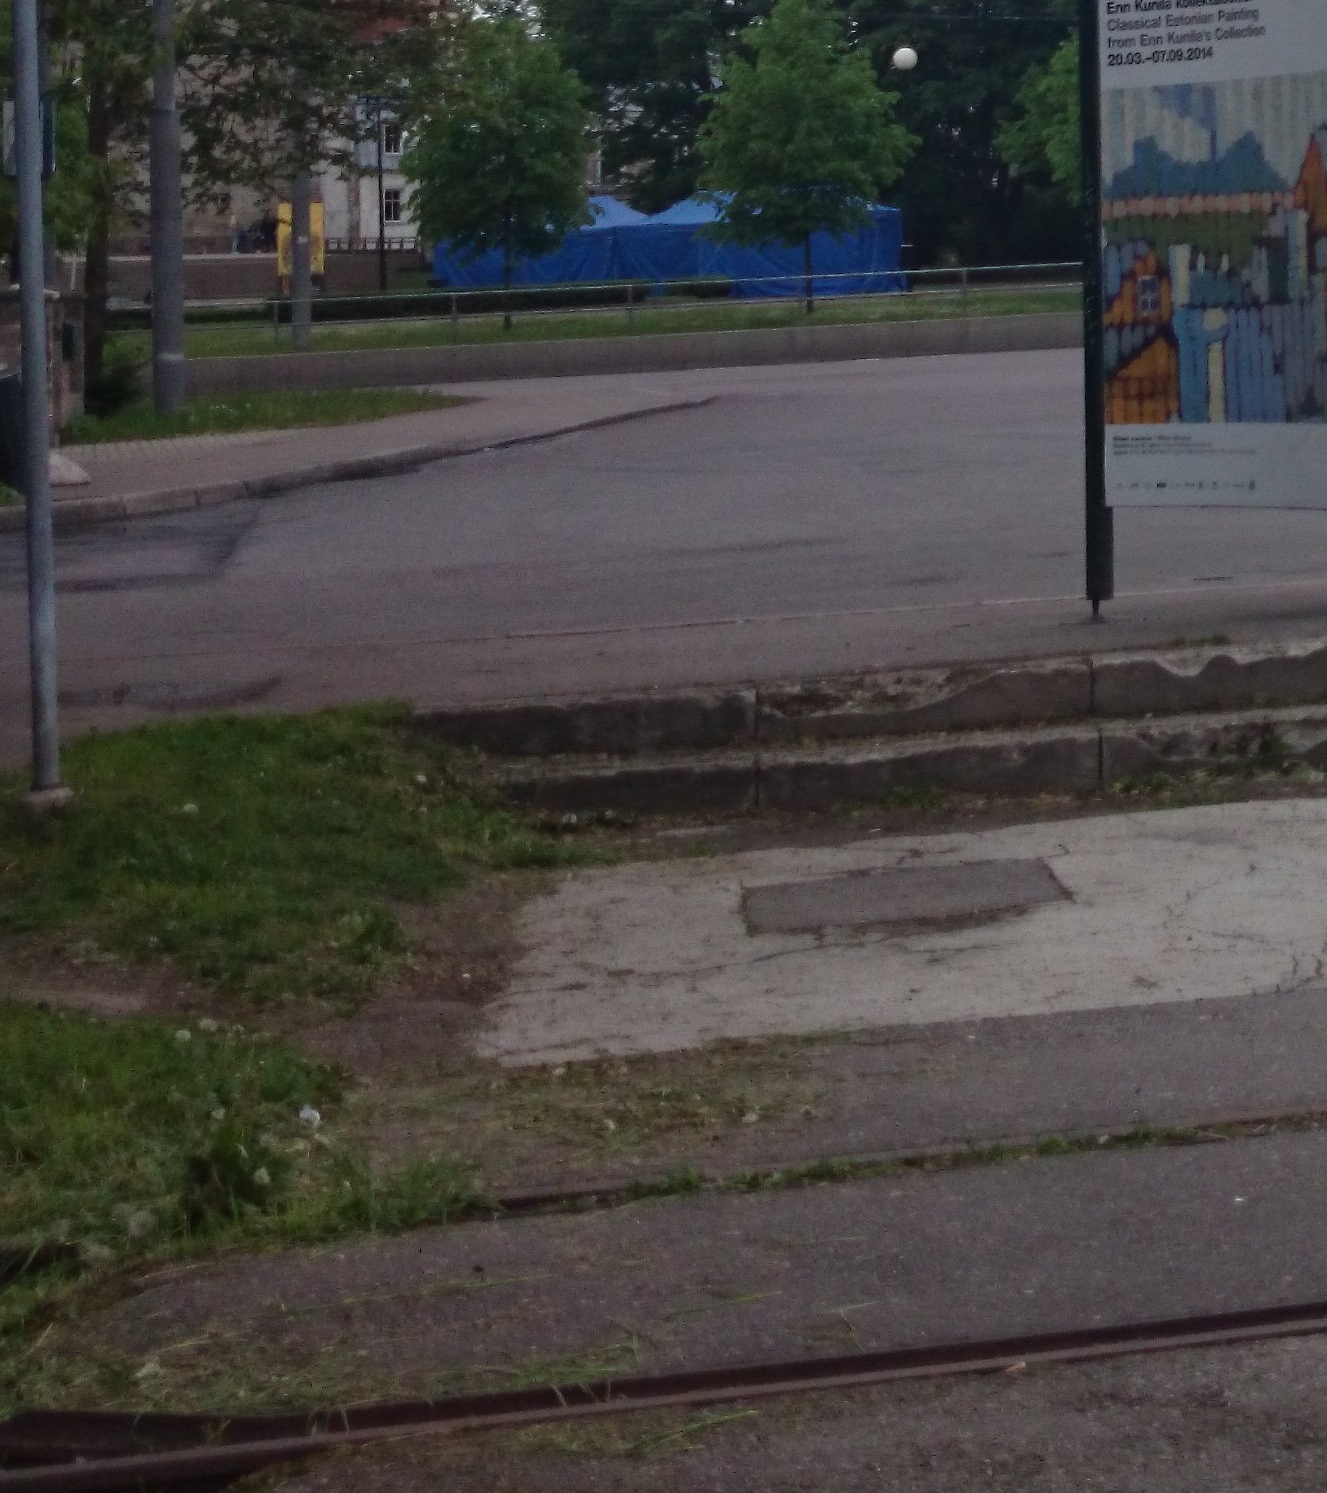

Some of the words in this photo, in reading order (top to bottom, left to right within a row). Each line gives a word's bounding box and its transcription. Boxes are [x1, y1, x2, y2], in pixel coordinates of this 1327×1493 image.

[1107, 1, 1131, 15] Enn
[1107, 16, 1161, 31] Classical
[1166, 12, 1214, 27] Estonian
[1218, 8, 1260, 23] Painting
[1108, 35, 1135, 49] from
[1140, 33, 1163, 47] Enn
[1215, 24, 1266, 41] Collection
